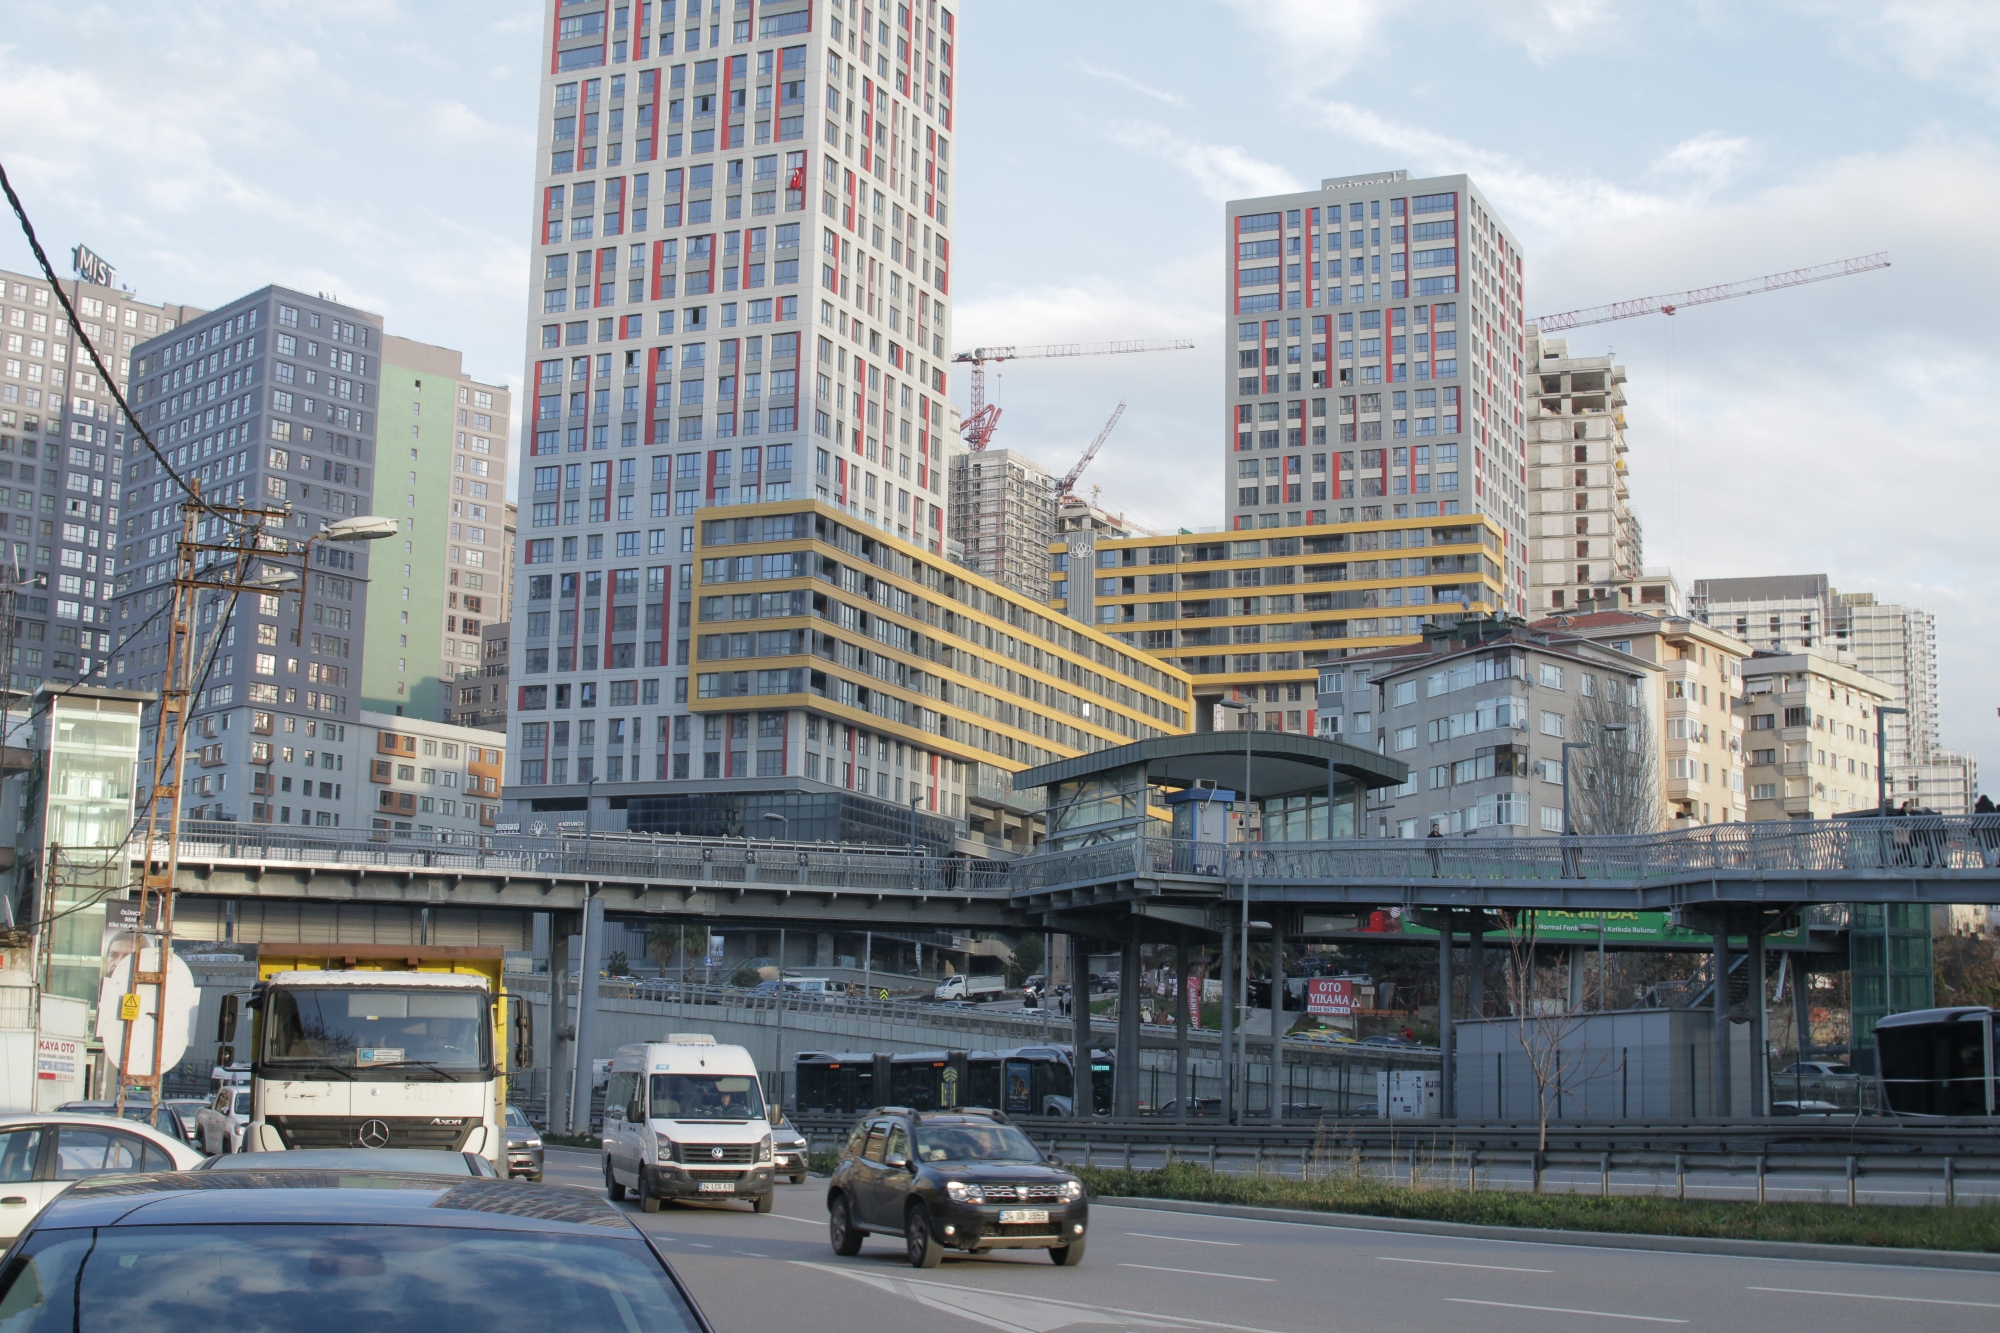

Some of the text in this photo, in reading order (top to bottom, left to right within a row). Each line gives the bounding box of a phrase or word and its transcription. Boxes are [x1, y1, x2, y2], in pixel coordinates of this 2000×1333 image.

[1319, 982, 1341, 992] OTO
[1309, 993, 1349, 1005] YIKAMA
[39, 1040, 75, 1053] KAYA OTO
